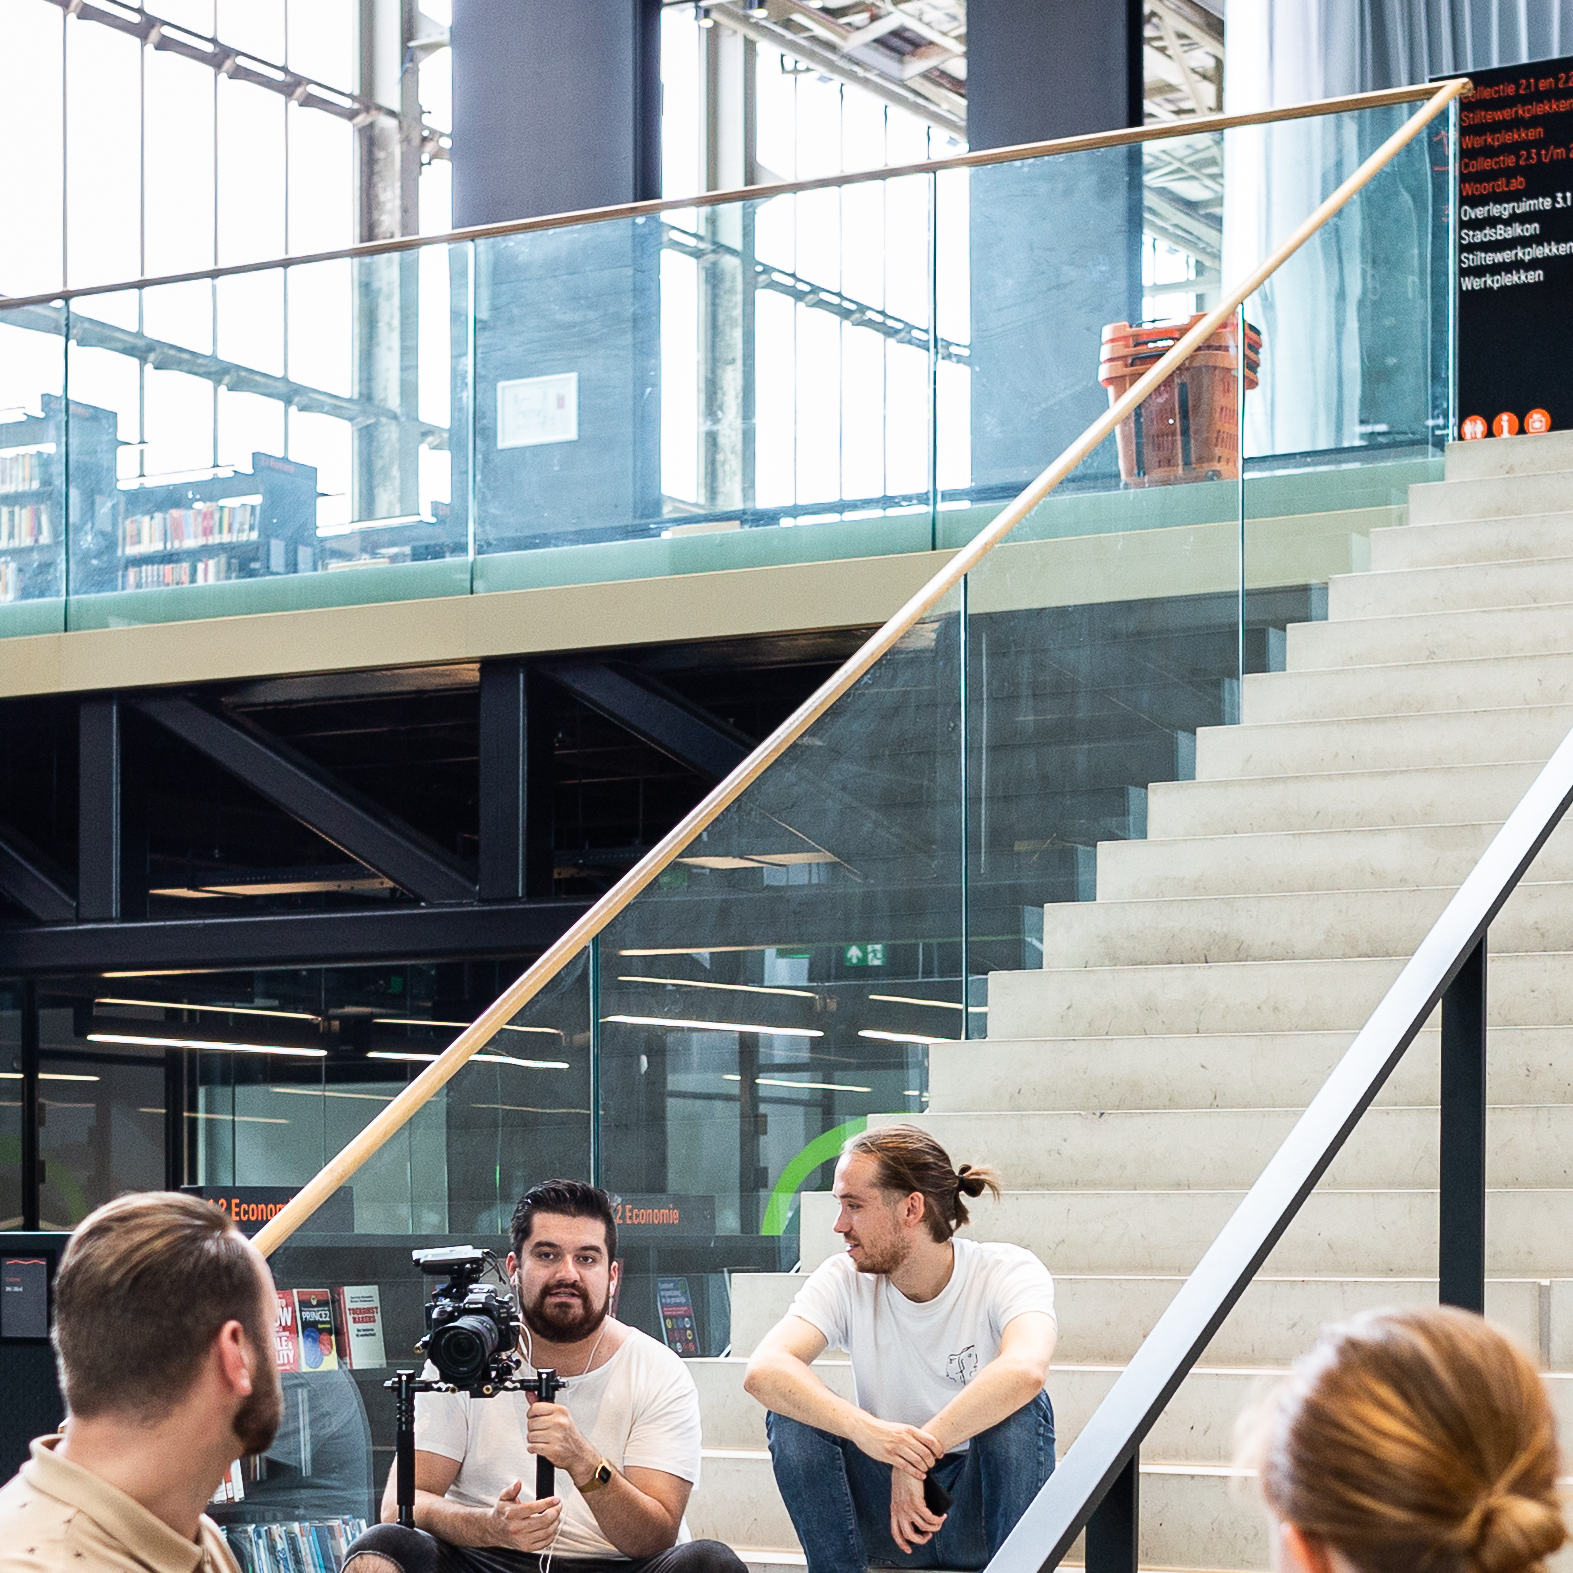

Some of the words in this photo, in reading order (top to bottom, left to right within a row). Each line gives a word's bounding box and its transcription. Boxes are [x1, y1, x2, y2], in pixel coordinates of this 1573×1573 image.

[1518, 78, 1536, 94] 2.1
[1538, 78, 1555, 91] en
[1460, 126, 1545, 150] Werkplekken
[1460, 153, 1516, 173] Collectie
[1518, 149, 1538, 166] 2.3
[1540, 145, 1567, 163] t/m
[1460, 176, 1526, 196] WoordLab
[1460, 196, 1553, 221] Overlegruimte
[1554, 191, 1572, 208] 3.1
[1460, 222, 1540, 245] StadsBalkon
[1460, 268, 1545, 291] Werkplekken
[231, 1197, 293, 1221] Econo
[625, 1203, 679, 1225] Economie
[301, 1311, 330, 1322] PRINCE2
